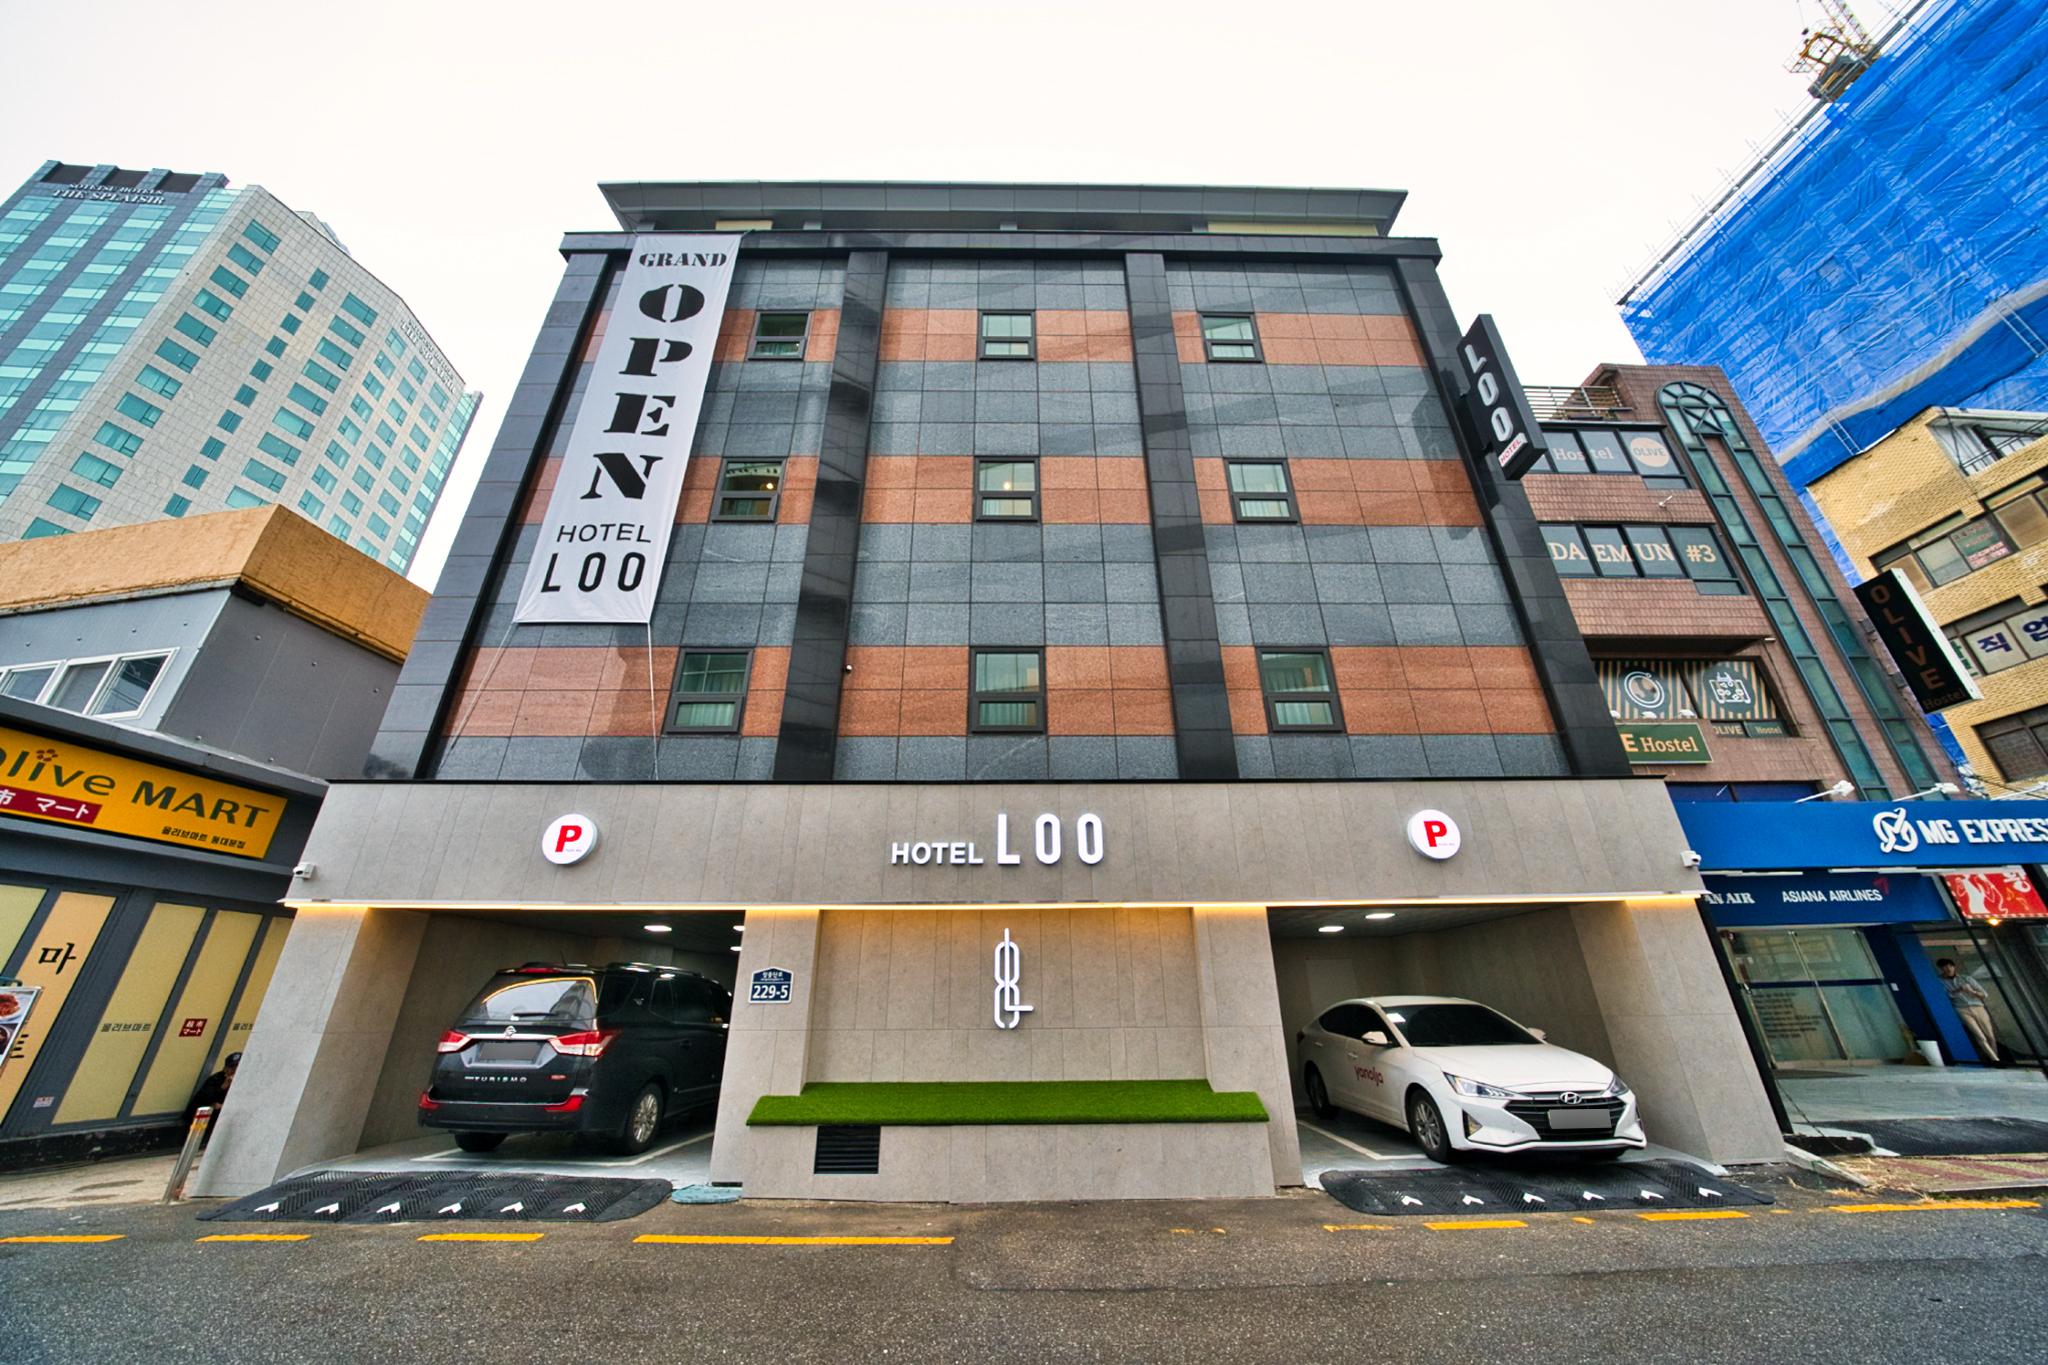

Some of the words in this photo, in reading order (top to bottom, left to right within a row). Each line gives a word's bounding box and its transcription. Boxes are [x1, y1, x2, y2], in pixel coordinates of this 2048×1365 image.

[53, 189, 86, 199] THE
[90, 192, 165, 205] SPLAISIR
[639, 253, 728, 267] GRAND
[579, 283, 705, 500] OPEN
[1465, 344, 1514, 442] LOO
[1500, 439, 1522, 463] HOTEL
[1552, 447, 1614, 460] Hostel
[1632, 447, 1665, 457] OLIVE
[556, 523, 652, 543] HOTEL
[1686, 544, 1717, 563] #3
[541, 552, 646, 592] LOO
[1870, 583, 1945, 690] OLIVE
[1640, 736, 1699, 752] Hostel
[0, 750, 116, 796] live
[131, 780, 270, 828] MART
[36, 797, 89, 819] マート
[555, 825, 582, 852] P
[891, 842, 984, 865] HOTEL
[997, 813, 1104, 865] LOO
[1423, 820, 1447, 847] P
[1916, 819, 1960, 844] MG
[1726, 892, 1756, 904] AIR
[1782, 890, 1828, 903] ASIANA
[1829, 889, 1883, 902] AIRLINES
[752, 985, 789, 999] 229-5
[1353, 1065, 1384, 1087] yanolja
